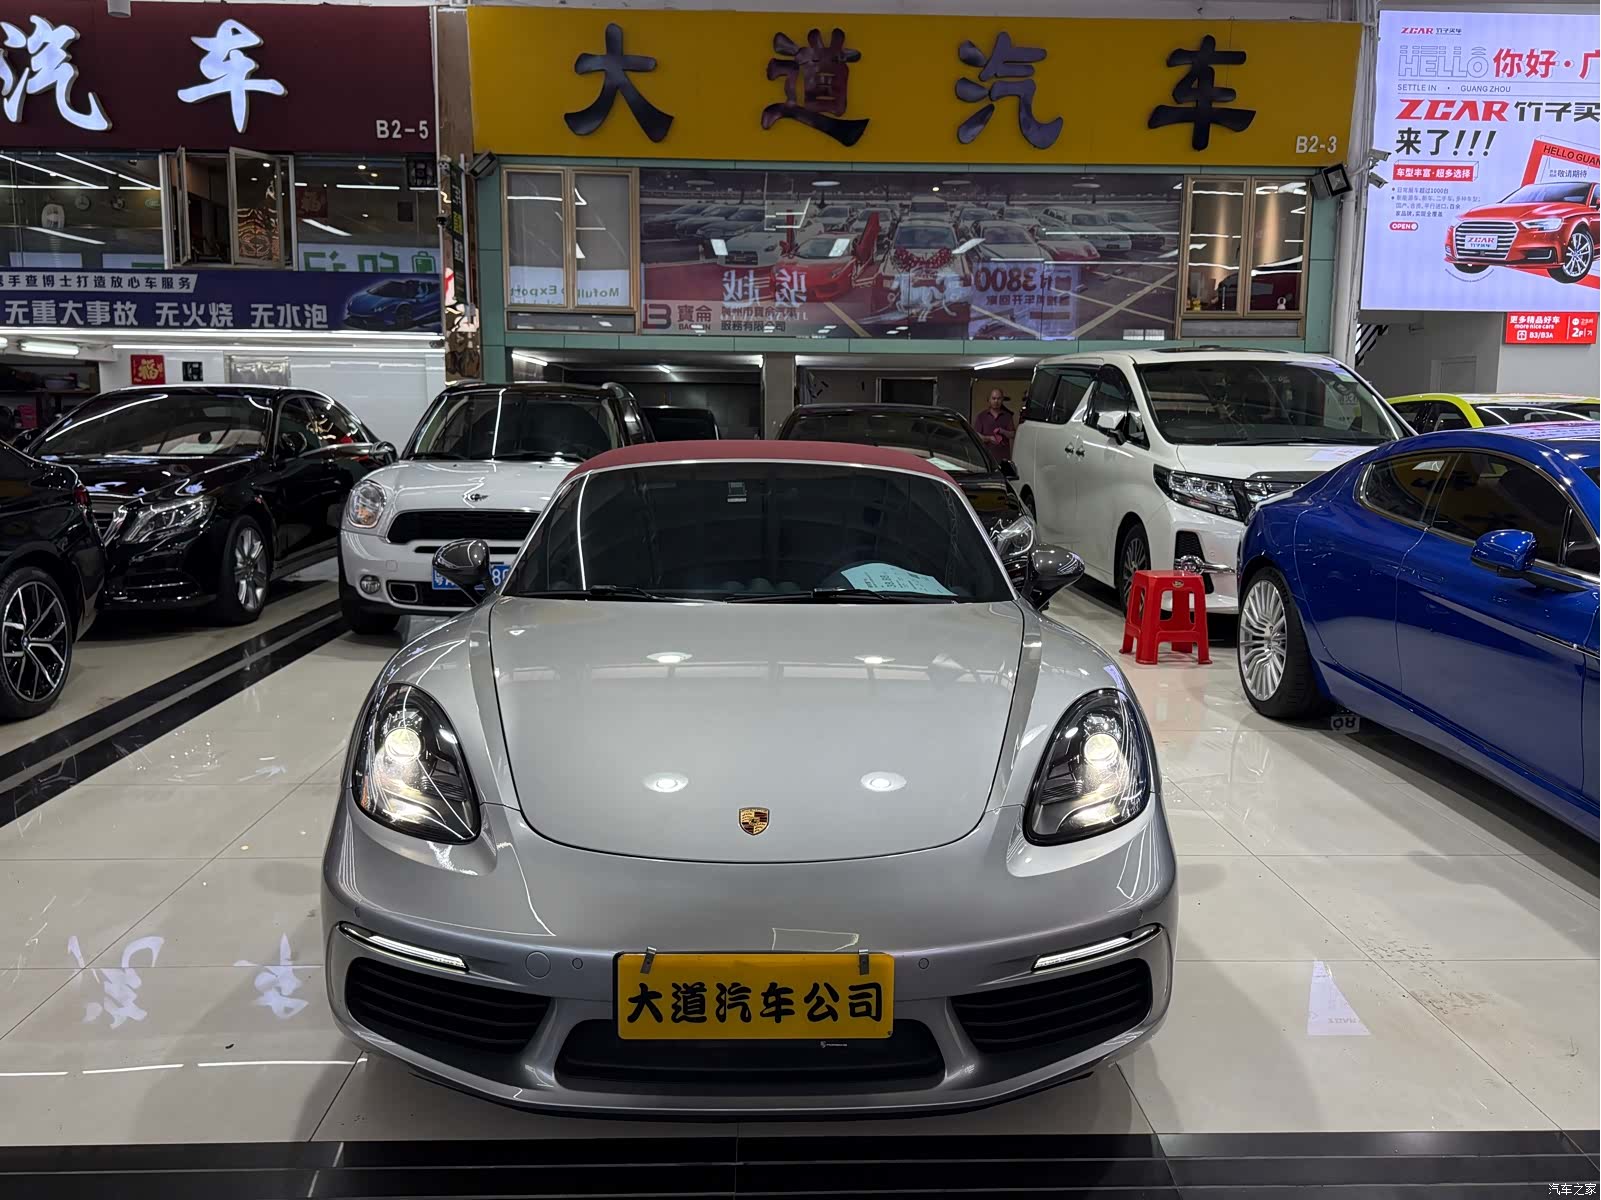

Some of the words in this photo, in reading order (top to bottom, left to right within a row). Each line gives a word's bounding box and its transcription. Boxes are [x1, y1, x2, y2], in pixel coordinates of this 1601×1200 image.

[563, 22, 1257, 151] 大道汽车
[1397, 84, 1426, 92] SETTLE
[1428, 84, 1437, 92] IN
[1460, 85, 1488, 93] GUANG
[1489, 85, 1511, 93] ZHOU
[1395, 99, 1510, 122] ZCAR
[376, 119, 430, 140] B2-5
[1295, 134, 1338, 155] B2-3
[1543, 145, 1575, 160] HELLO
[5, 300, 139, 327] 无重大事故
[155, 301, 234, 328] 无火烧
[251, 303, 329, 329] 无水泡
[626, 981, 884, 1024] 大道汽车公司
